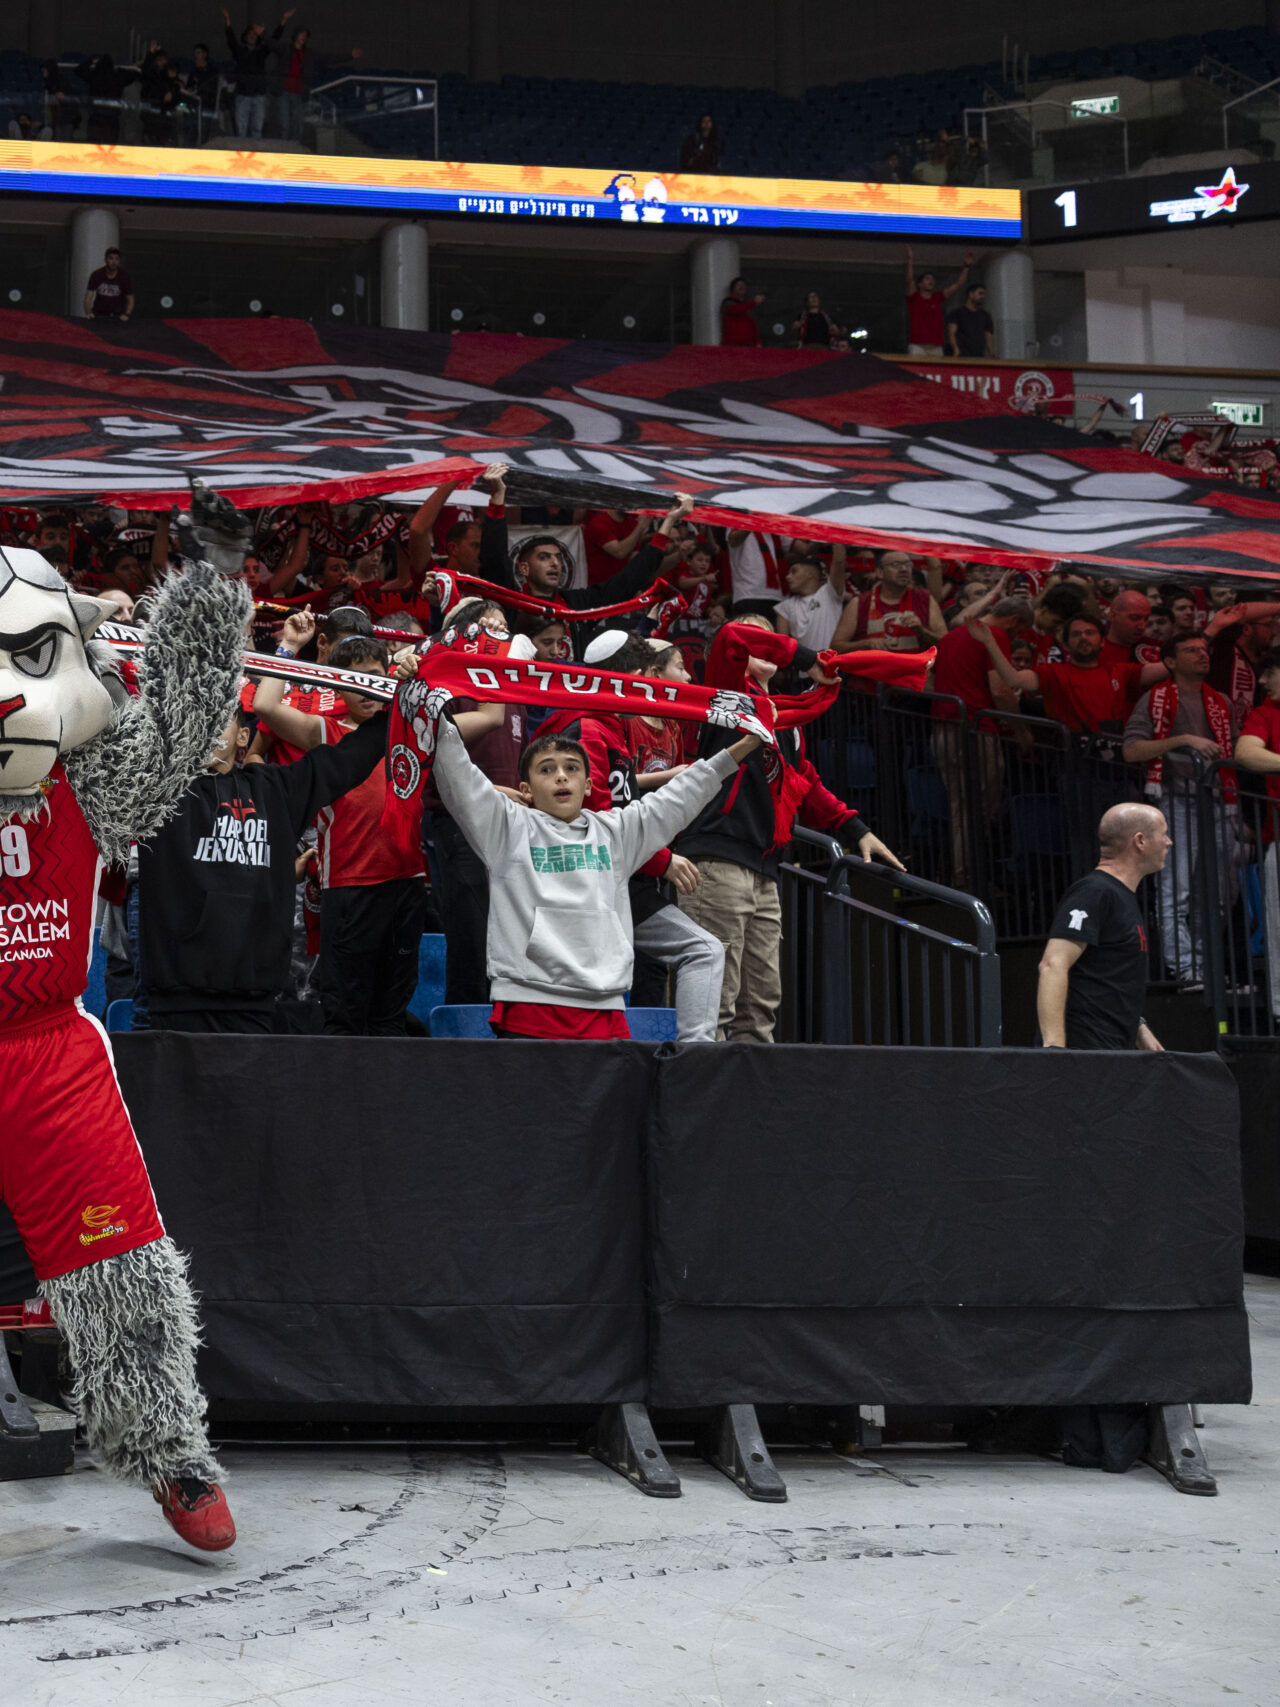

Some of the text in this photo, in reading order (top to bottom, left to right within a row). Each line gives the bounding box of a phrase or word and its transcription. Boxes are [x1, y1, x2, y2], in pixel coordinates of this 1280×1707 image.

[571, 202, 595, 218] מים
[681, 206, 739, 227] עין גדי
[1054, 190, 1077, 228] 1
[1130, 392, 1144, 420] 1
[466, 663, 679, 703] ירושלים
